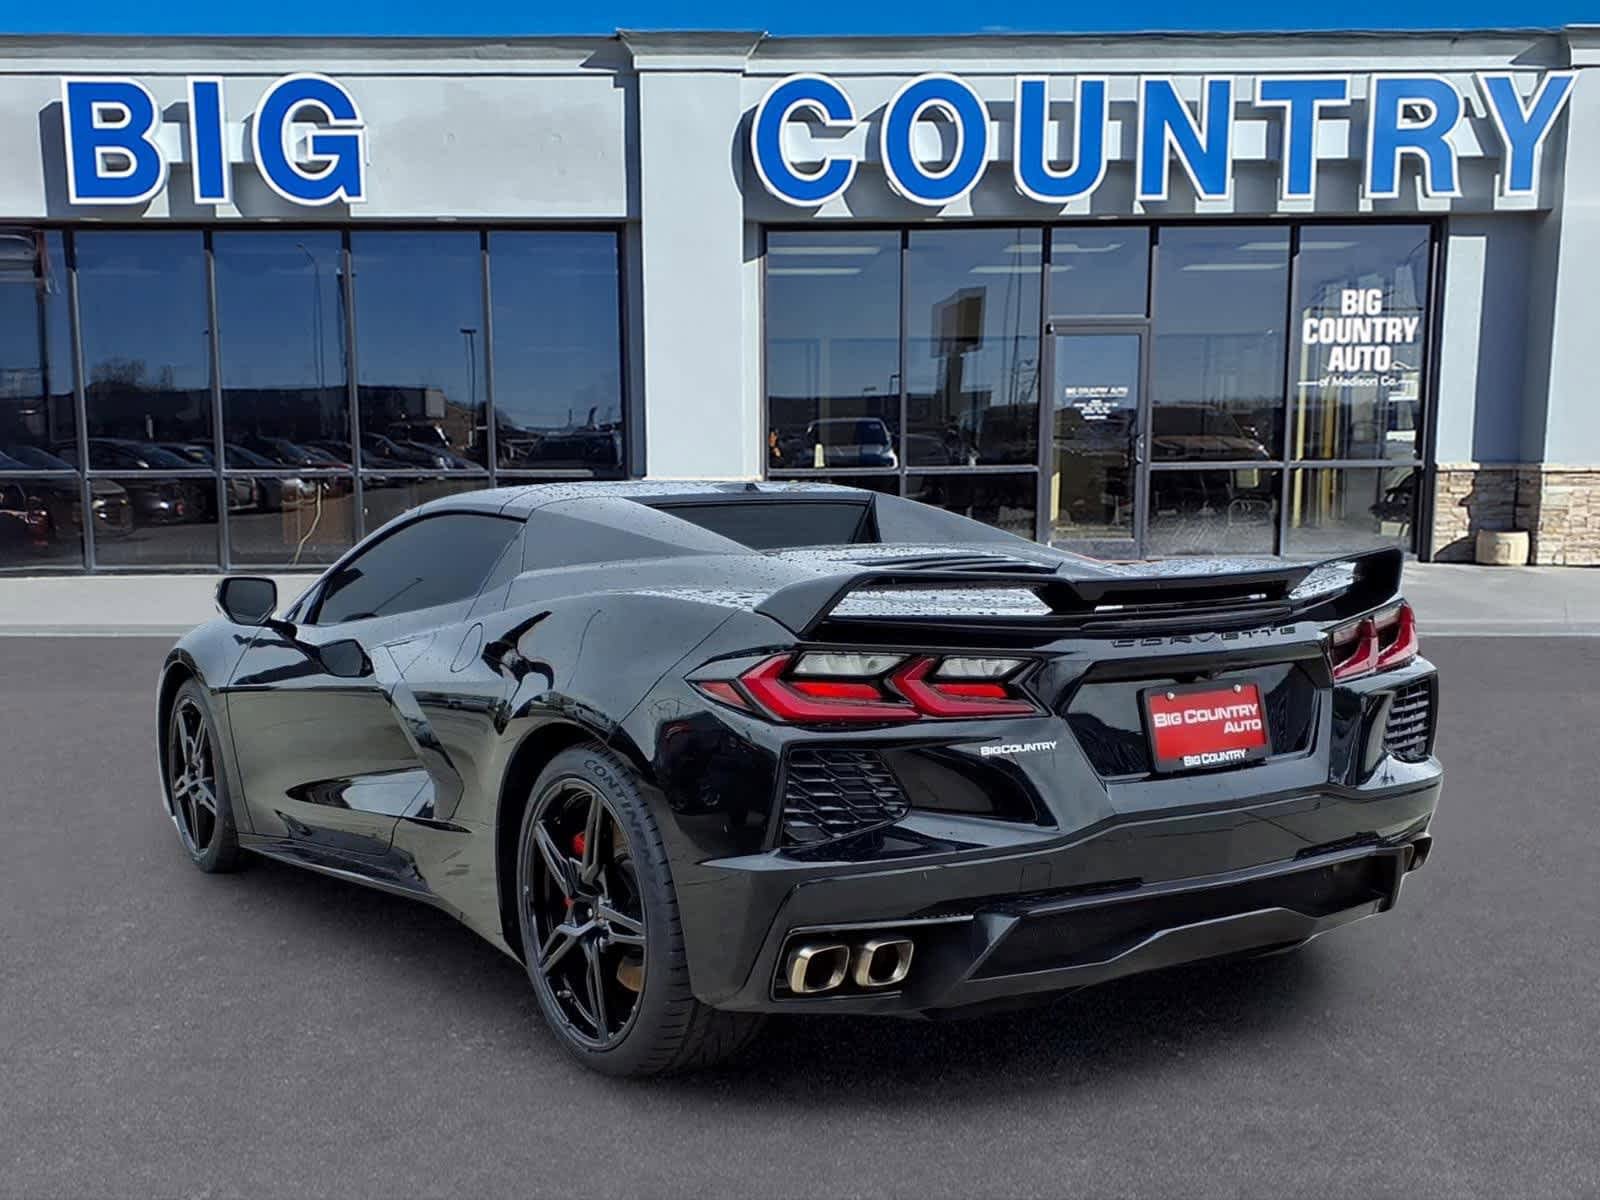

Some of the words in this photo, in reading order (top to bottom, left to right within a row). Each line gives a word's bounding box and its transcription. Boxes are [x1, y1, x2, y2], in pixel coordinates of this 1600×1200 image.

[61, 73, 366, 205] BIG
[751, 71, 1579, 208] COUNTRY
[1341, 288, 1383, 316] BIG
[1303, 316, 1419, 345] COUNTRY
[1327, 345, 1392, 372] AUTO
[1319, 375, 1329, 387] of
[1331, 375, 1378, 387] Madison
[1111, 626, 1297, 648] CORVETTE
[1153, 713, 1182, 728] BIG
[1183, 703, 1259, 724] COUNTRY
[1223, 718, 1263, 734] AUTO
[980, 741, 1057, 756] BIGCOUNTRY
[1183, 754, 1201, 767] BIG
[1201, 748, 1247, 764] COUNTRY
